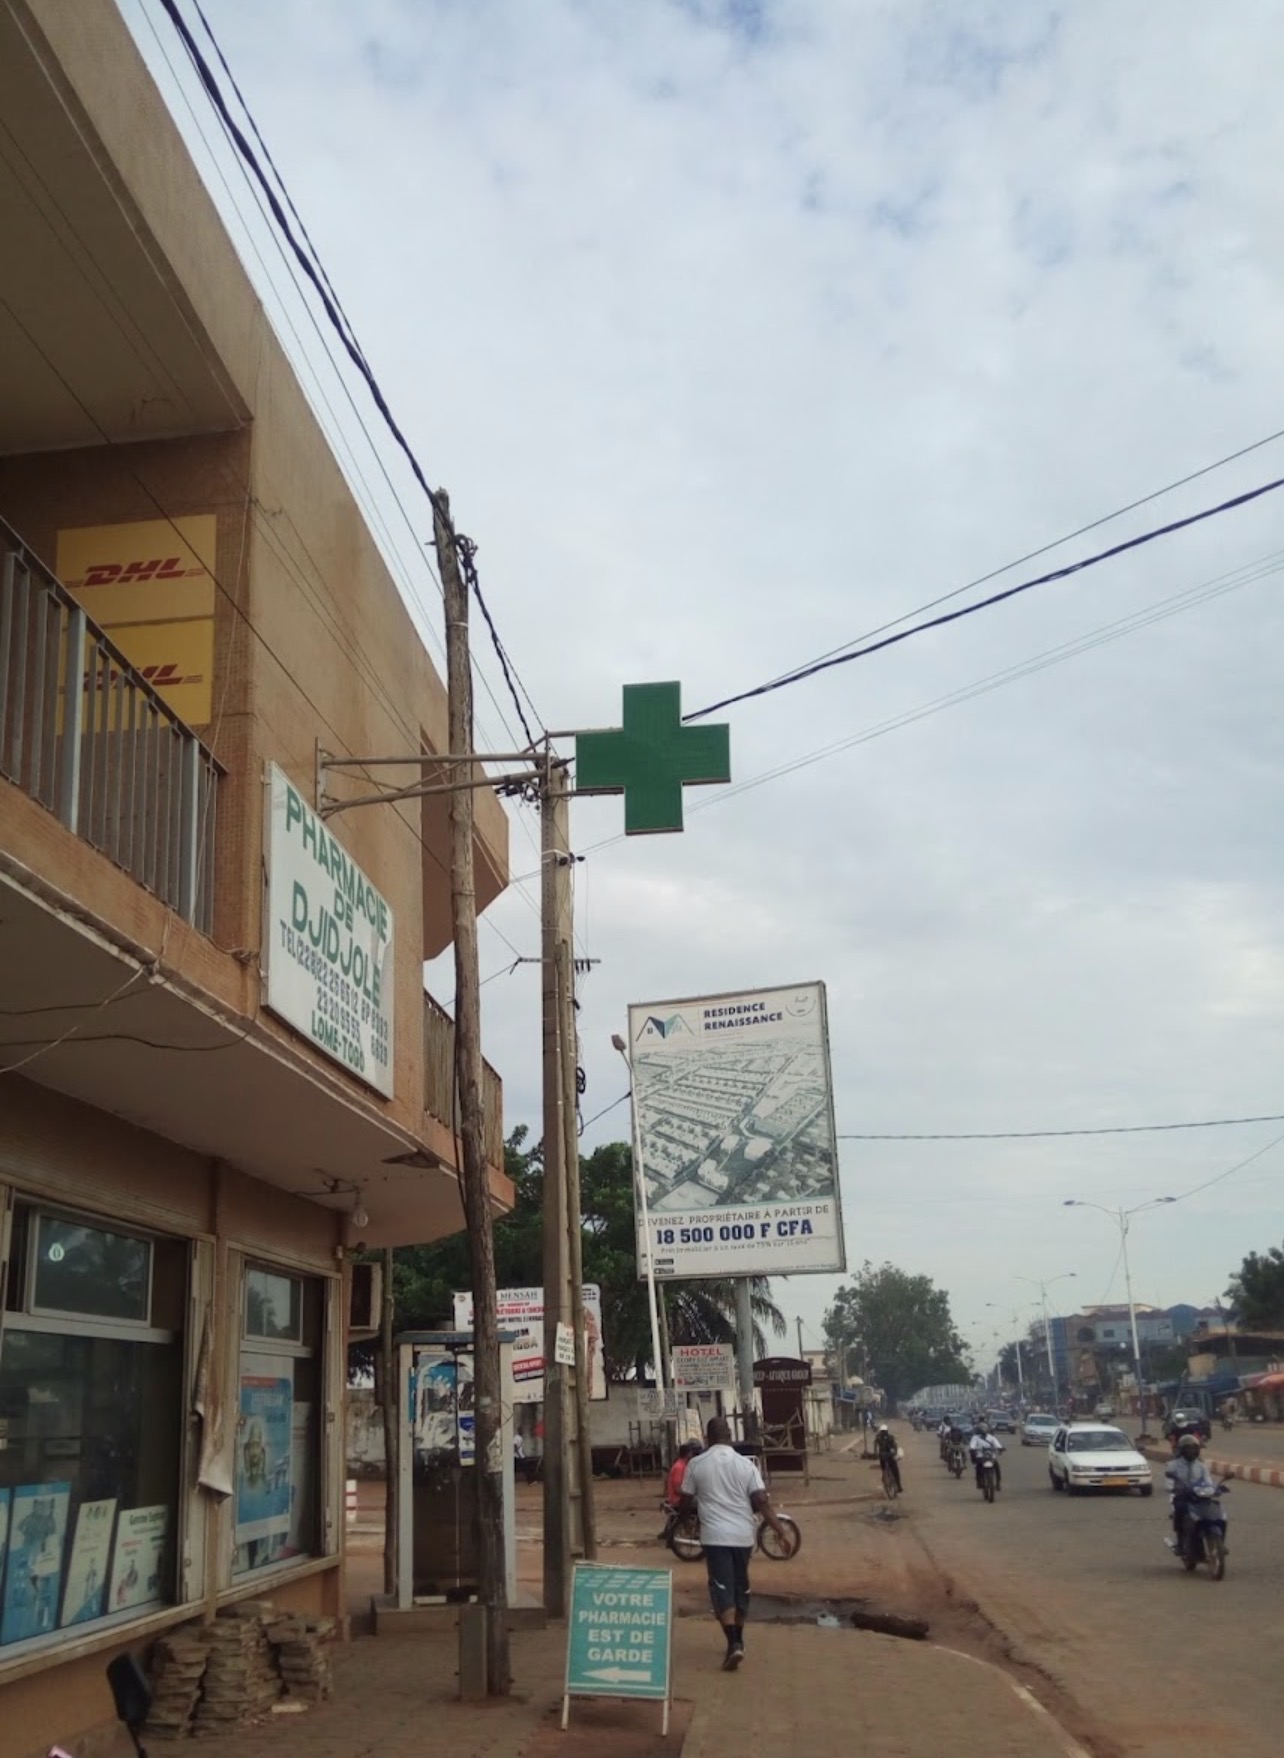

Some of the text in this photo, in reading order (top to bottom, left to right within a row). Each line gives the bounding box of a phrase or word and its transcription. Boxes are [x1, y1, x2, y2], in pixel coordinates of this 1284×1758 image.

[83, 557, 186, 586] DHL
[286, 783, 387, 943] PHARMACIE
[334, 887, 354, 933] DE
[292, 880, 380, 1009] DJIDJOLE
[704, 1002, 765, 1018] RESIDENCE
[704, 1012, 784, 1030] RENAISSANCE
[689, 1209, 761, 1225] PROPRIÉTAIRE
[774, 1206, 813, 1217] PARTIR
[815, 1205, 829, 1215] DE
[657, 1219, 813, 1244] 18 500 000 F CFA
[500, 1291, 538, 1300] MENSAH
[680, 1347, 723, 1356] HOTEL
[593, 1592, 654, 1607] VOTRE
[579, 1611, 665, 1625] PHARMACIE
[588, 1629, 654, 1644] EST DE
[587, 1647, 653, 1663] GARDE
